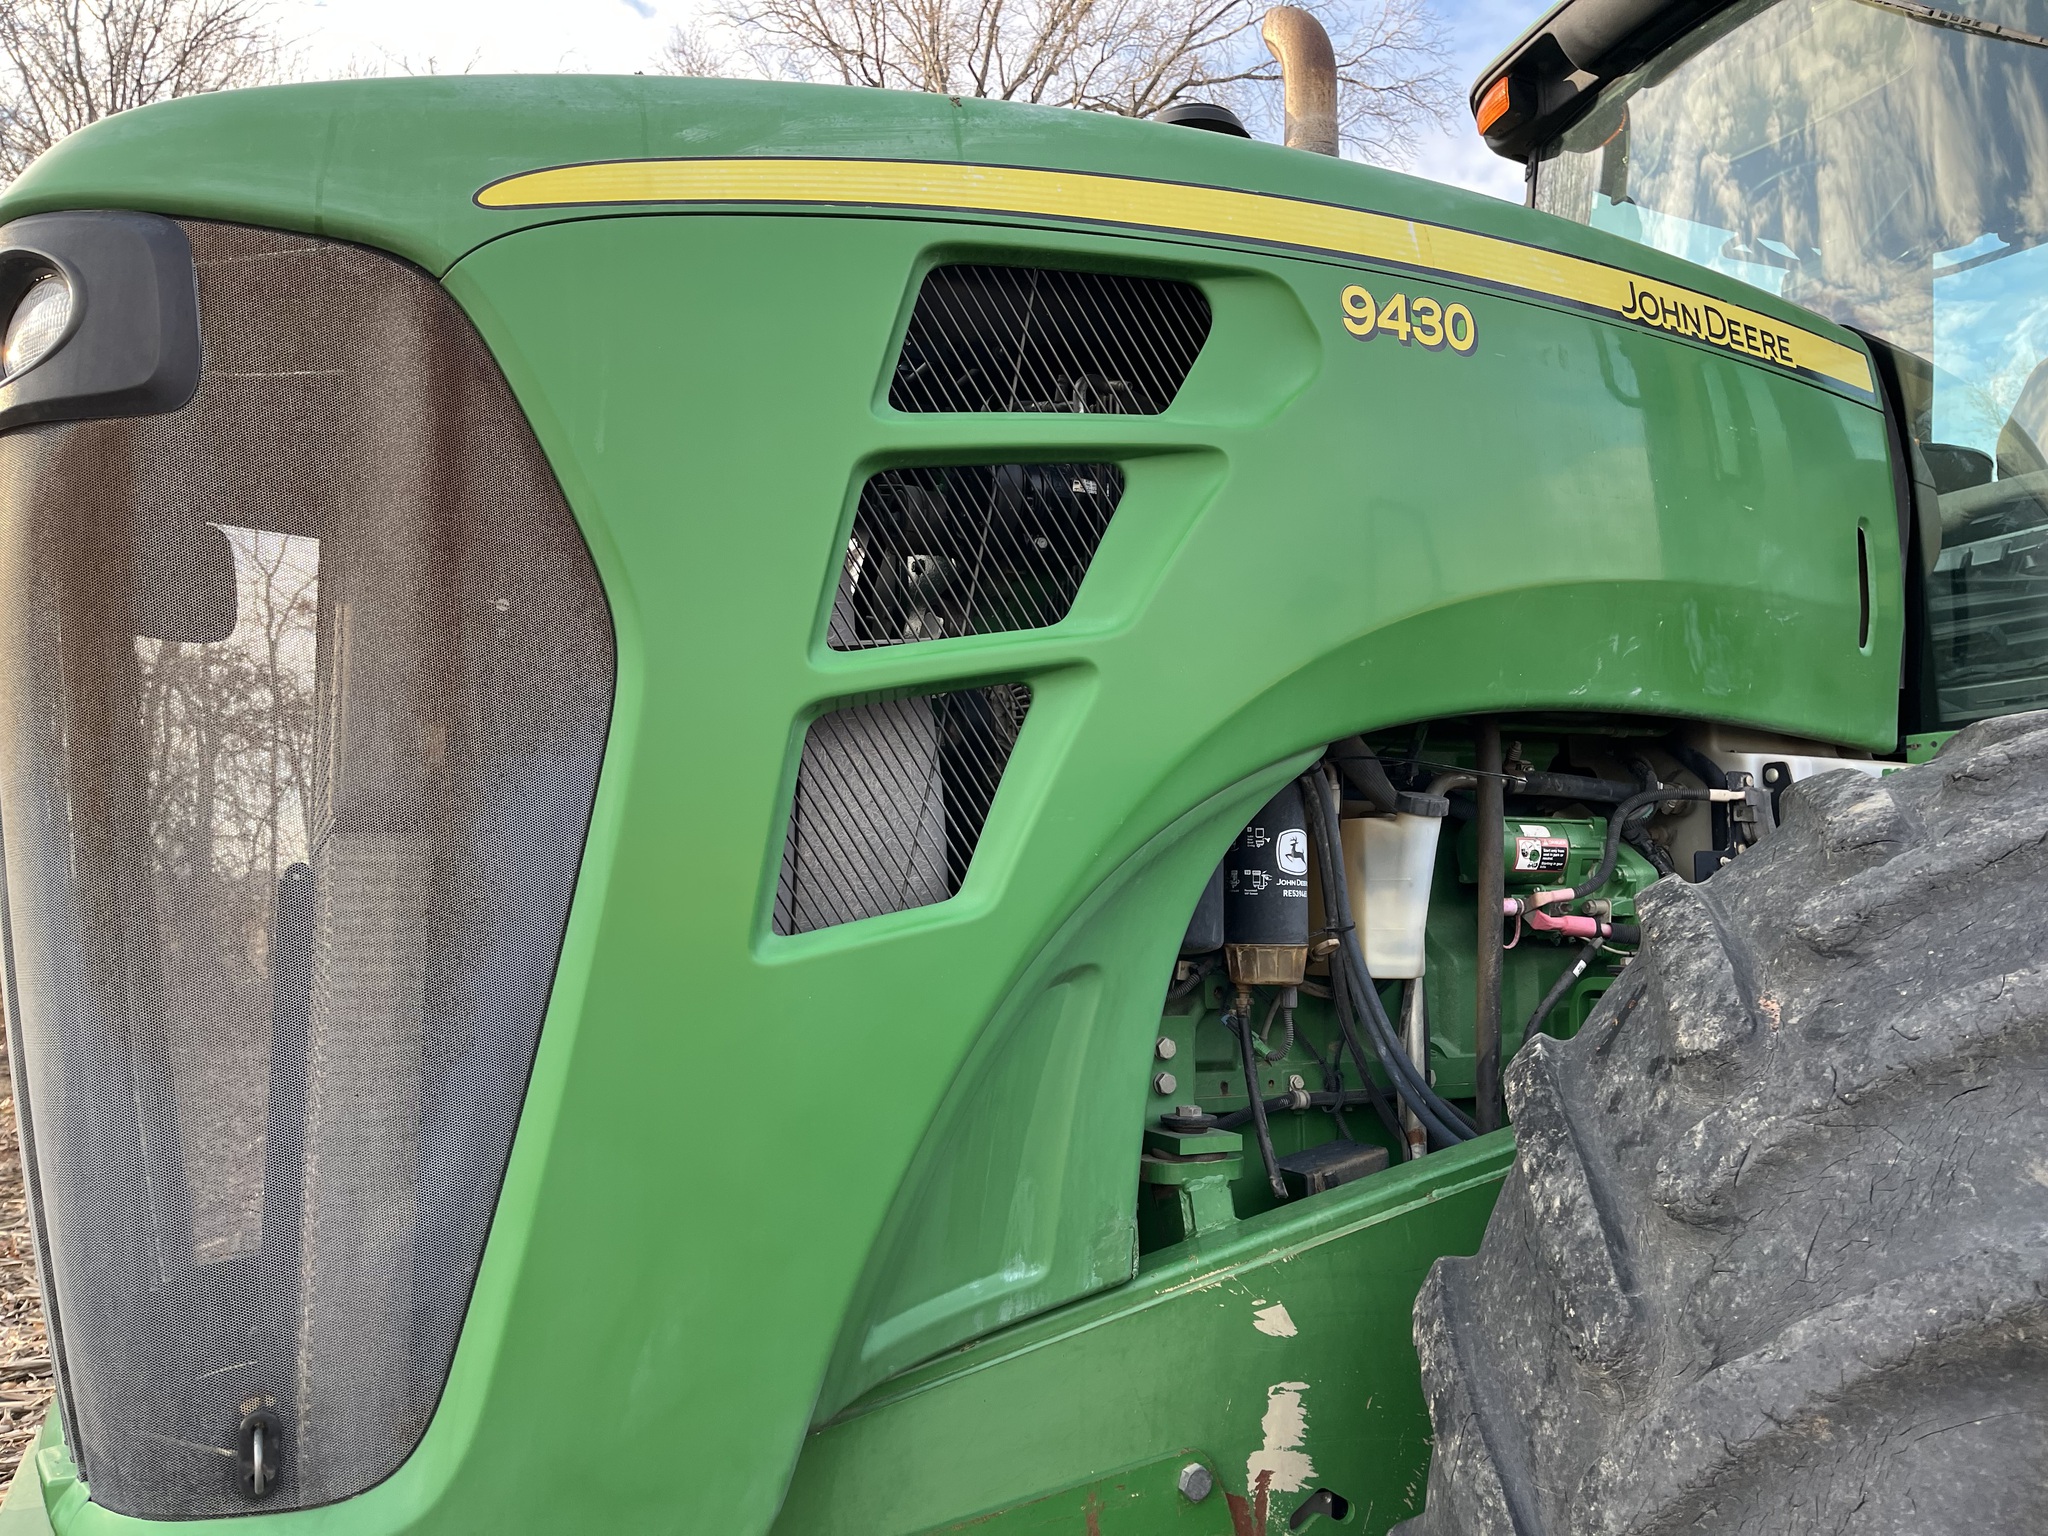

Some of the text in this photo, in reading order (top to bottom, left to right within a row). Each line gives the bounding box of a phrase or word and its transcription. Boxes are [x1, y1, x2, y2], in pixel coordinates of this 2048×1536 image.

[1340, 284, 1478, 356] 9430
[1622, 281, 1795, 365] JOHN DEERE
[1276, 878, 1296, 886] JOHN
